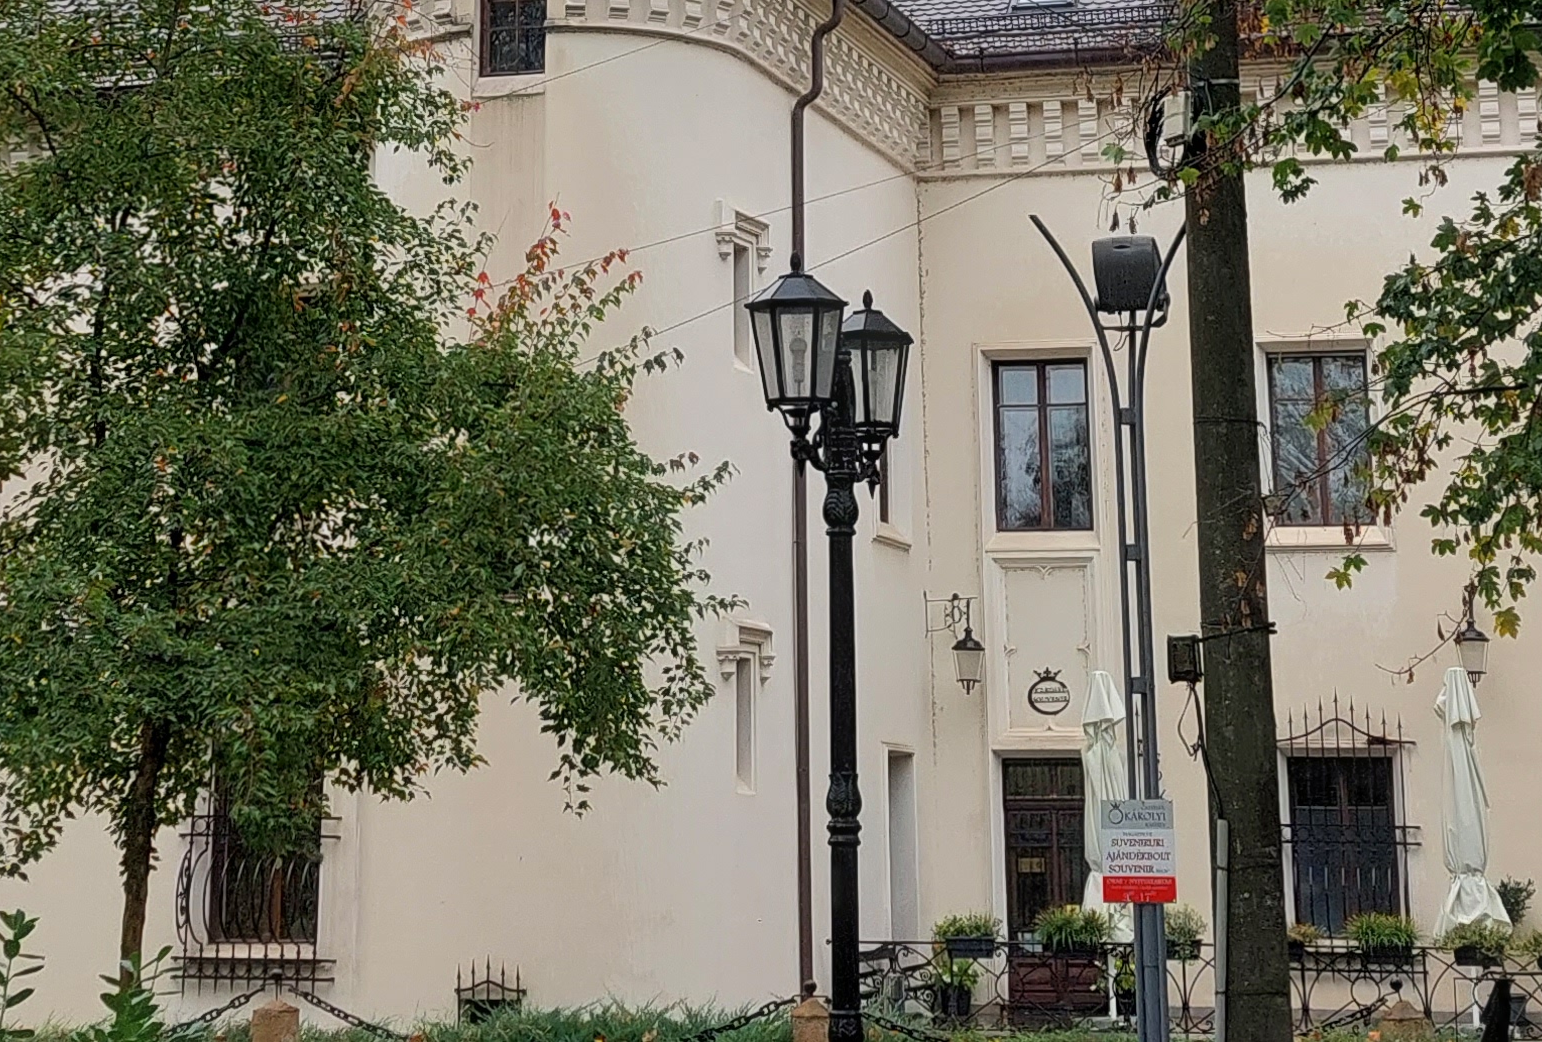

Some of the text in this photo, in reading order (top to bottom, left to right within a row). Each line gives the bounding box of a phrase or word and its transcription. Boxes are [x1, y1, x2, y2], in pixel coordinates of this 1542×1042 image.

[1124, 809, 1166, 821] KÁROLYI
[1106, 849, 1171, 862] AJÁNDÉKBOLT
[1108, 863, 1155, 873] SOUVENIR
